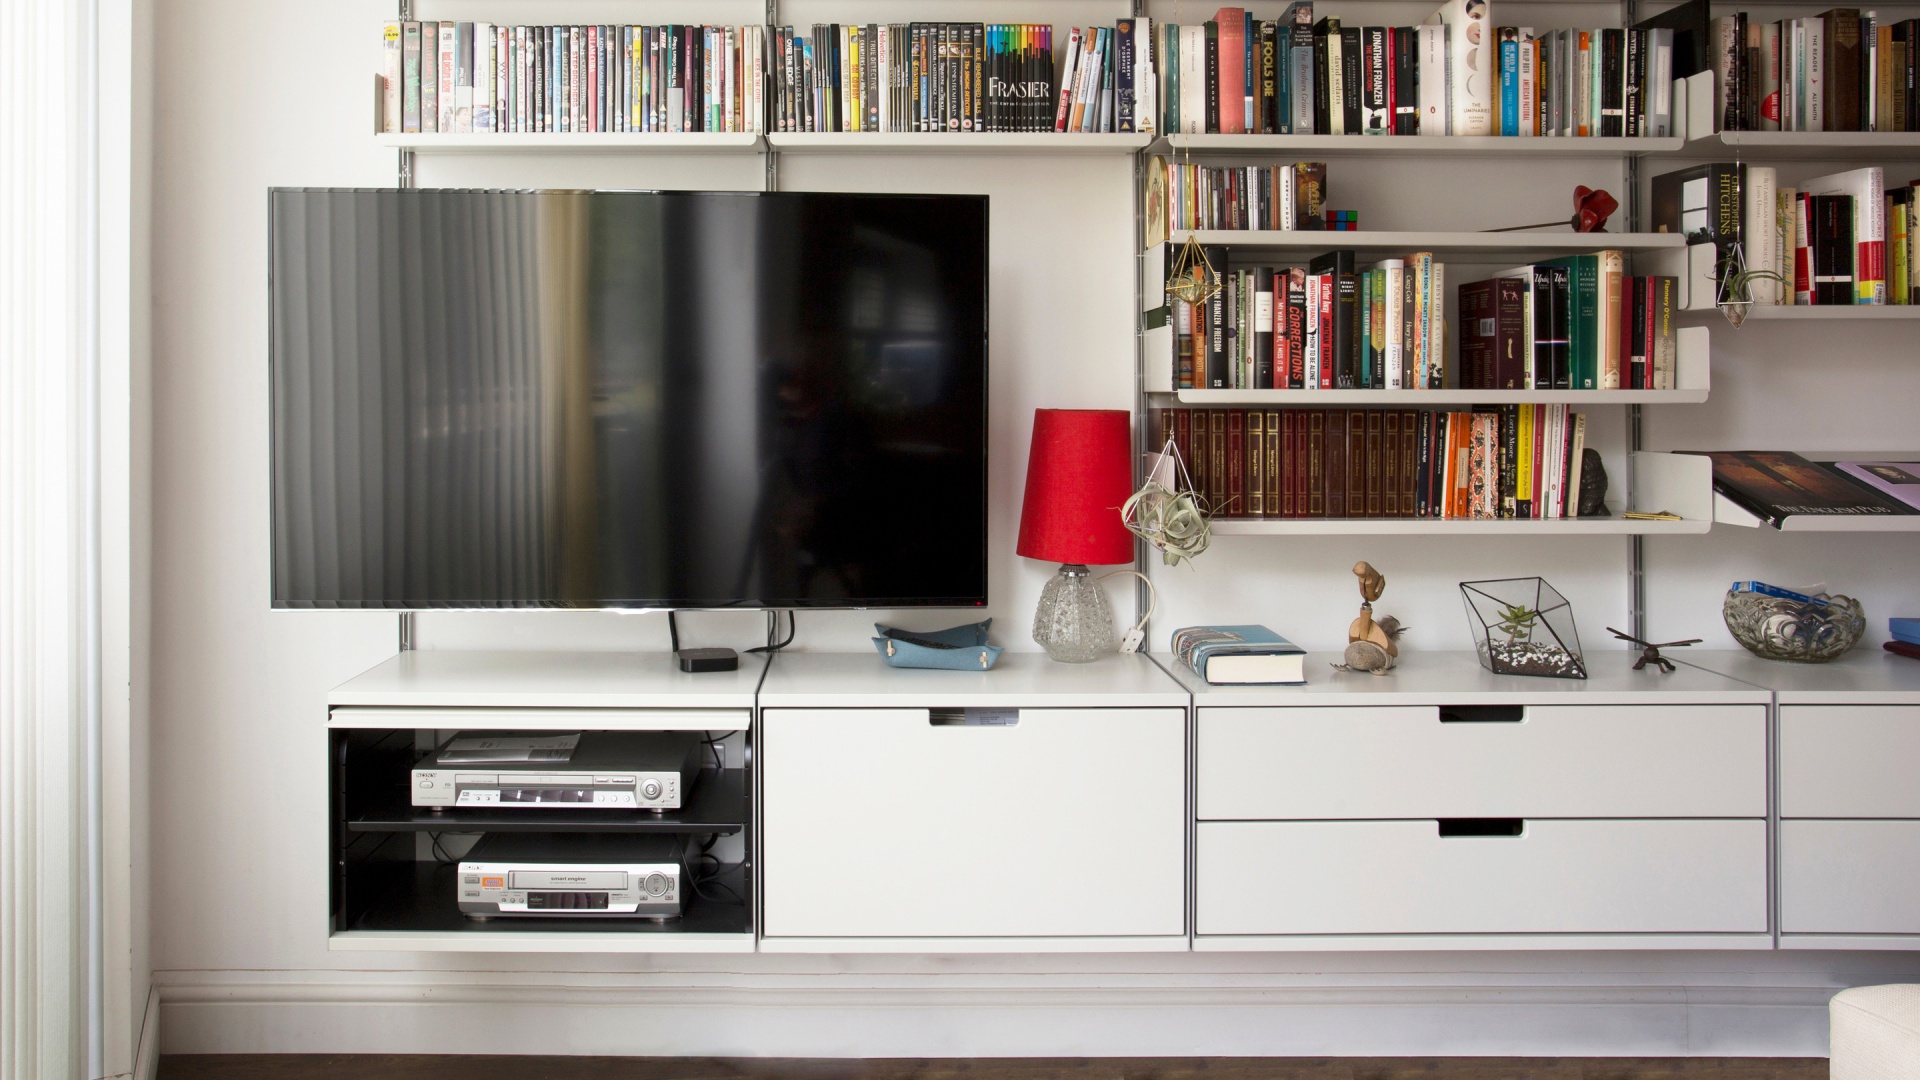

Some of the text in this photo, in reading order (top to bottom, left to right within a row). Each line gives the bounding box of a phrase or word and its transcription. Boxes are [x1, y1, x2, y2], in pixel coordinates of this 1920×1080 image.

[426, 38, 434, 80] DELIVERANCE
[1264, 42, 1273, 97] FOOLS DIE
[1372, 31, 1382, 105] JONATHAN FRANZEN
[989, 77, 1050, 98] FRASIER
[1299, 64, 1308, 91] Brothers
[1334, 56, 1342, 105] david sedaris
[1299, 94, 1308, 117] Grimm
[1720, 174, 1730, 235] HITCHENS
[1321, 283, 1332, 301] Farther
[1321, 301, 1332, 314] Away
[1435, 303, 1441, 312] OF
[1435, 314, 1441, 322] IT
[1289, 306, 1302, 381] CORRECTIONS
[1661, 338, 1669, 364] Complete
[1772, 505, 1891, 514] THE ENGLISH PUB
